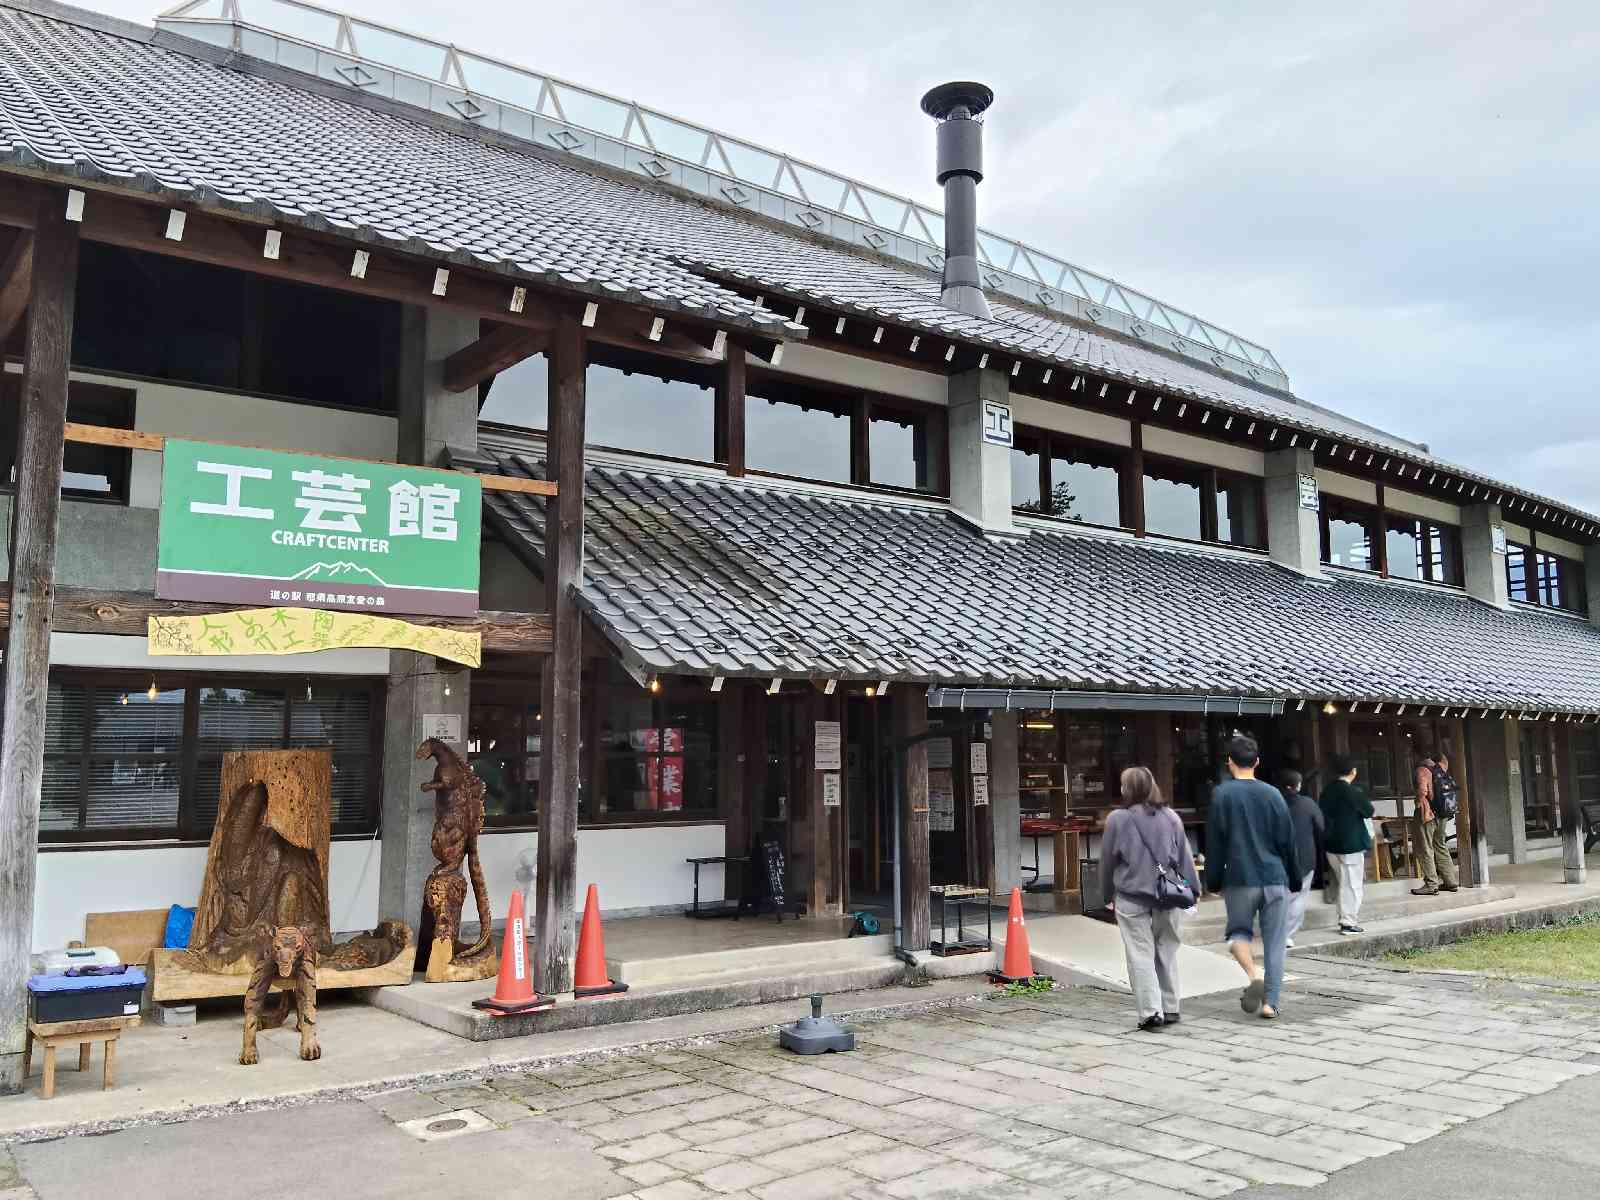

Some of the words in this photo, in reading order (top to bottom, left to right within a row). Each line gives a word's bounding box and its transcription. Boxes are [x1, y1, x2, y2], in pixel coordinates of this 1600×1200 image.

[190, 461, 461, 541] 工芸館
[271, 529, 390, 553] CRAFTCENTER
[270, 590, 302, 601] 道の駅
